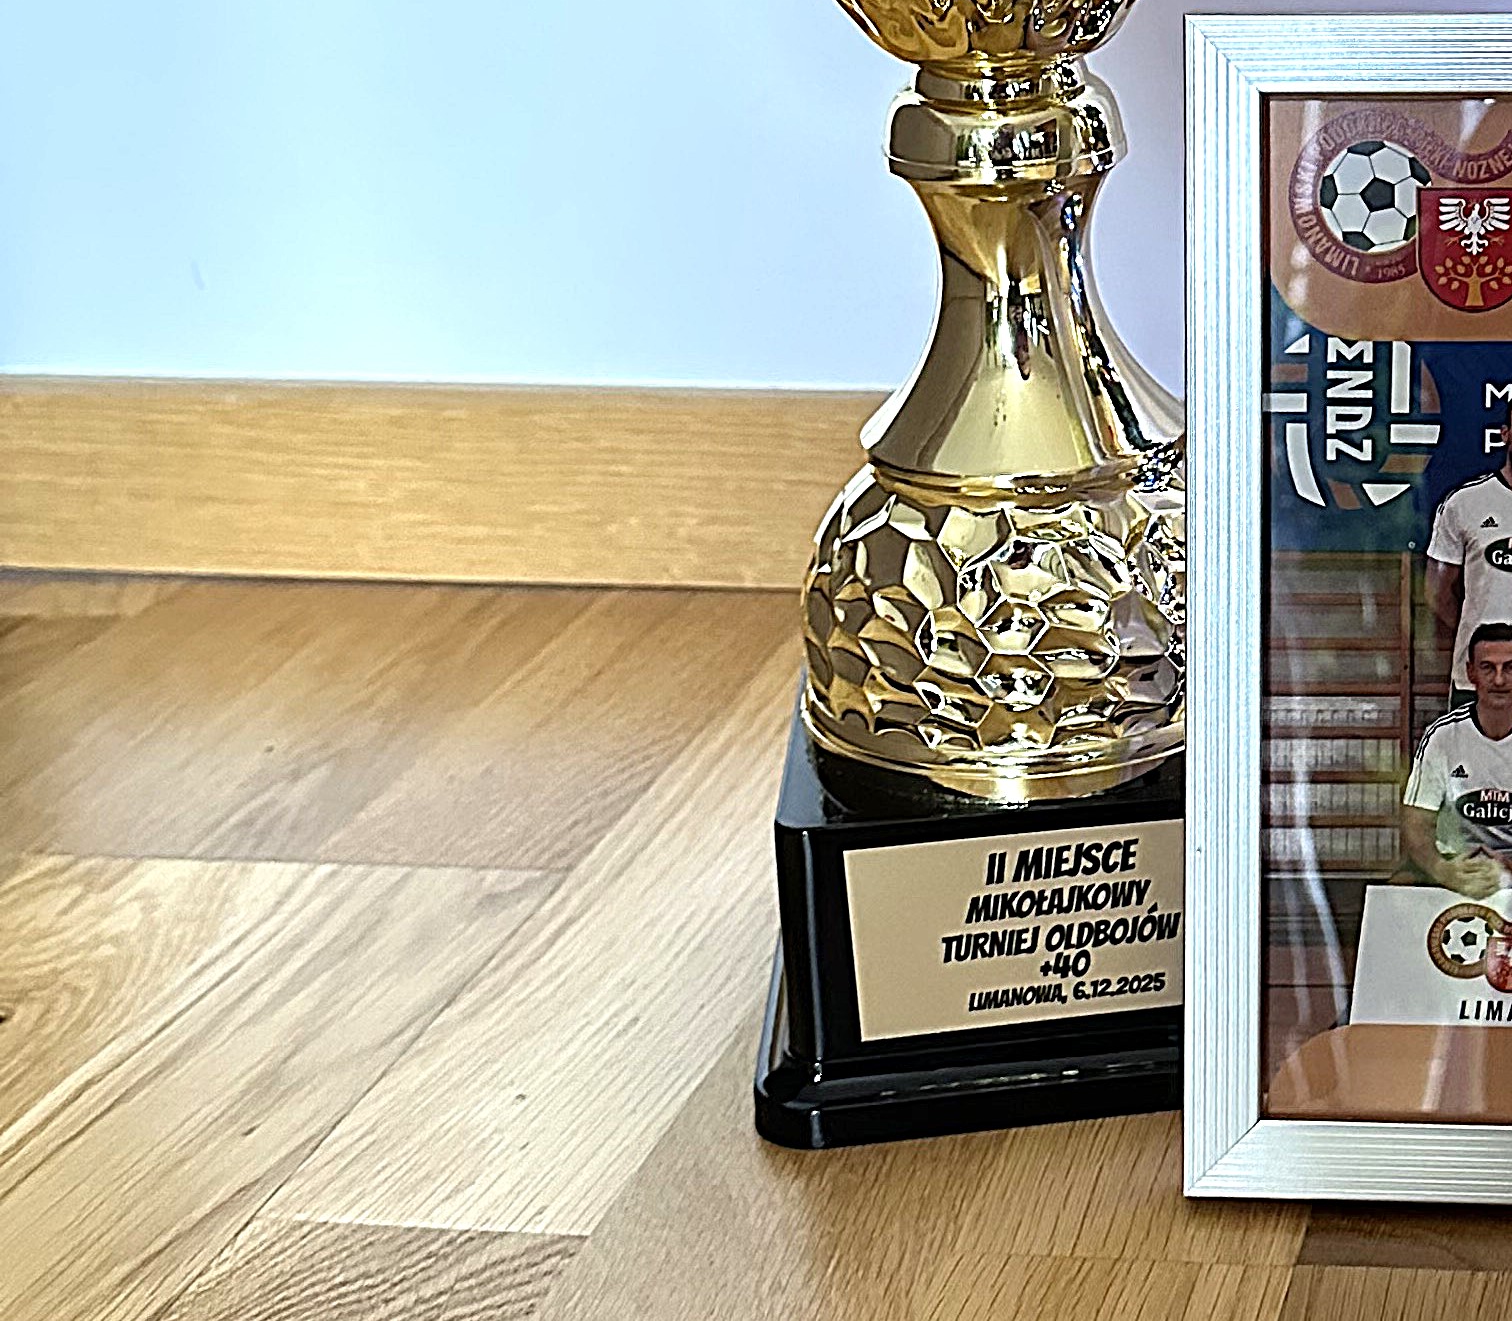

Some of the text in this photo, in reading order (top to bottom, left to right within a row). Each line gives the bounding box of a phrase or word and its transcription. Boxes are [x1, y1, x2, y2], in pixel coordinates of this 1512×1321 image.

[985, 838, 1140, 885] II MIEJSCE
[965, 878, 1152, 925] MIKOŁAJKOWY
[941, 902, 1182, 964] TURNIEJ OLDBOJÓW
[1039, 949, 1092, 980] +40
[967, 972, 1167, 1013] LIMANOWA, 6.12.2025
